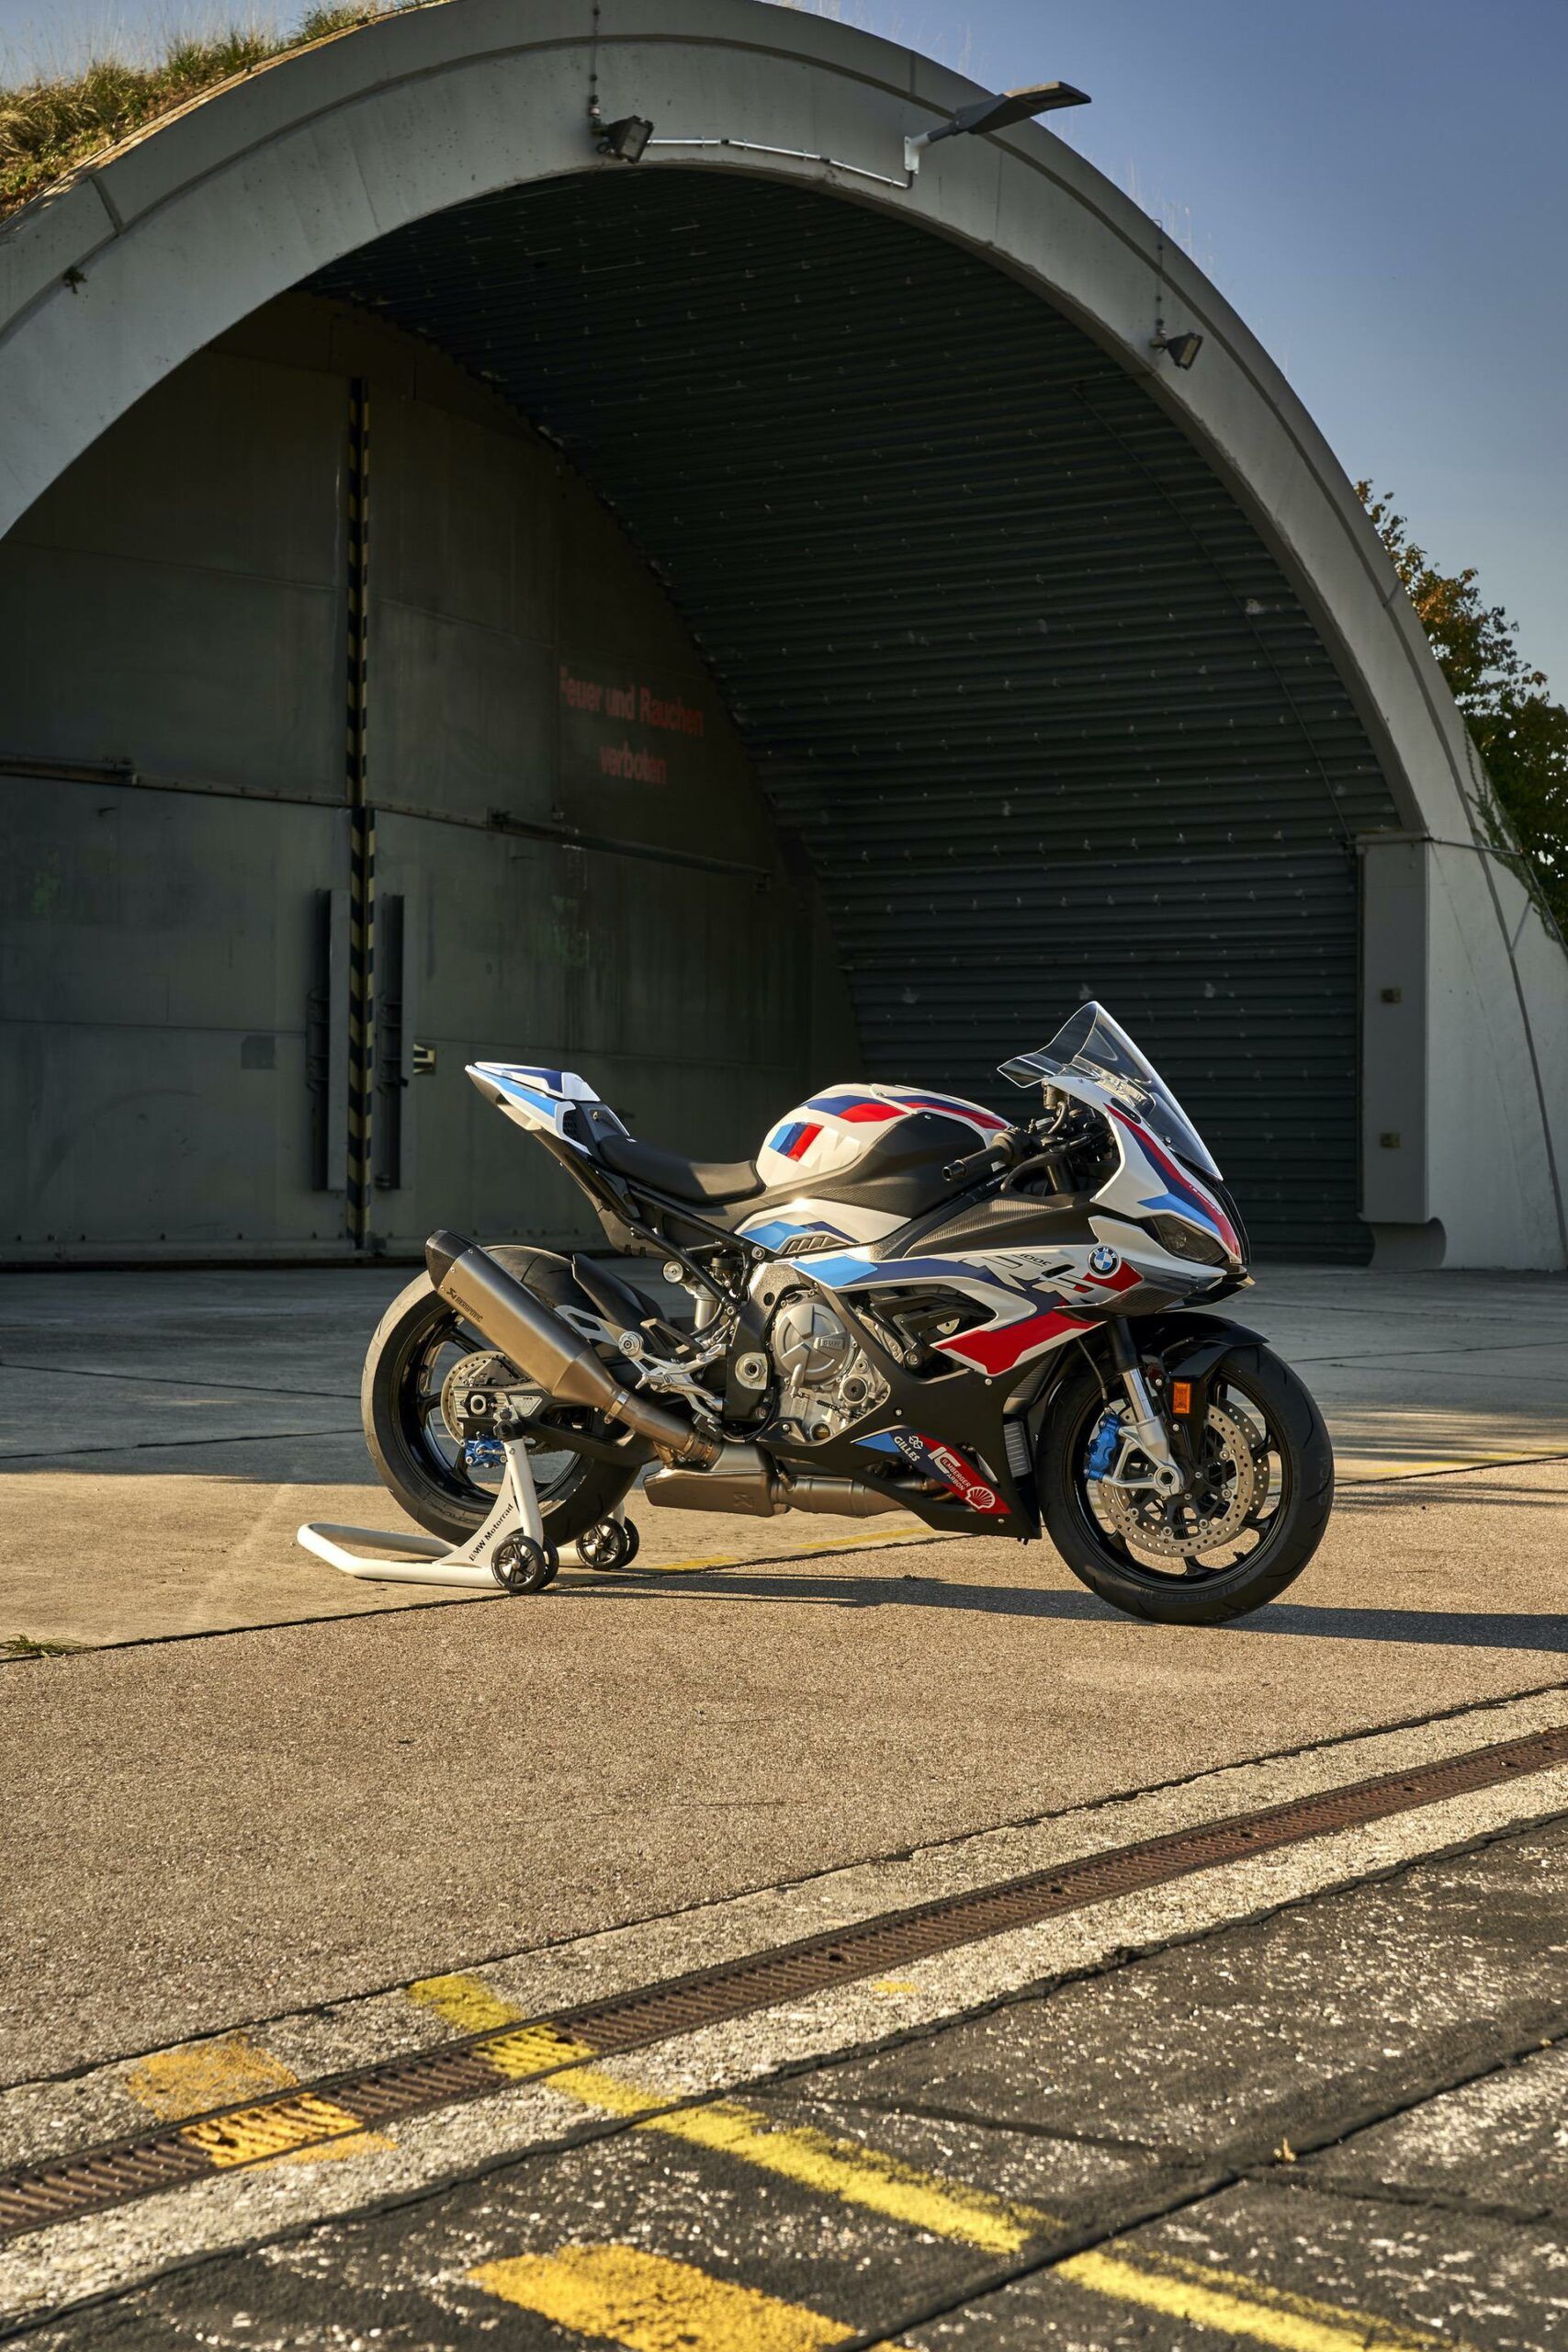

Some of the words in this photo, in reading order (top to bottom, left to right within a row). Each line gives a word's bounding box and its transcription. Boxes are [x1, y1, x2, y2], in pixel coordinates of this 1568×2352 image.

[604, 684, 636, 721] und
[893, 1435, 920, 1462] GILLES
[468, 1540, 487, 1562] BMW
[485, 1503, 514, 1540] Motorrad
